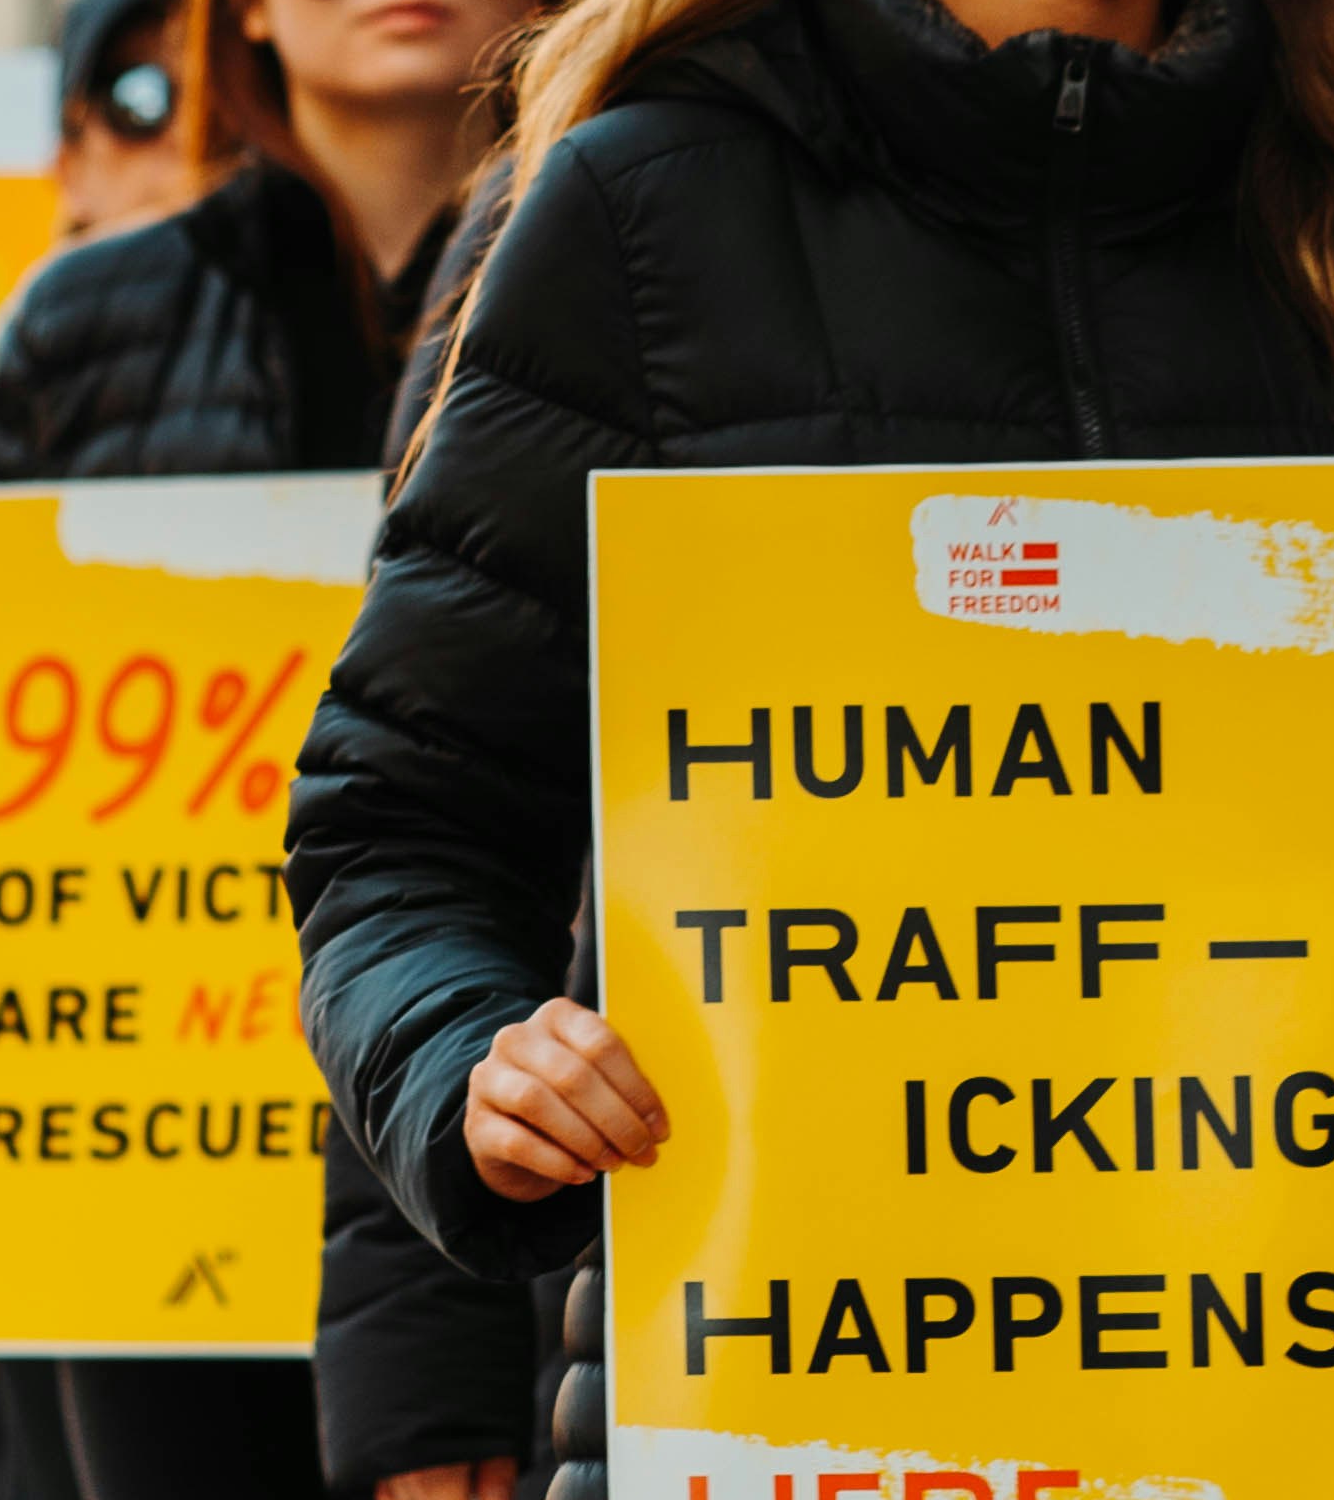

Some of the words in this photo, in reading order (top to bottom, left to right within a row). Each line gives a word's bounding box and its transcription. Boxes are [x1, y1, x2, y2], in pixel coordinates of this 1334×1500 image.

[947, 542, 1016, 562] WALK
[948, 568, 995, 589] FOR
[948, 593, 1061, 615] FREEDOM
[666, 700, 1164, 802] HUMAN
[120, 863, 288, 924] VICT
[176, 968, 304, 1044] NE
